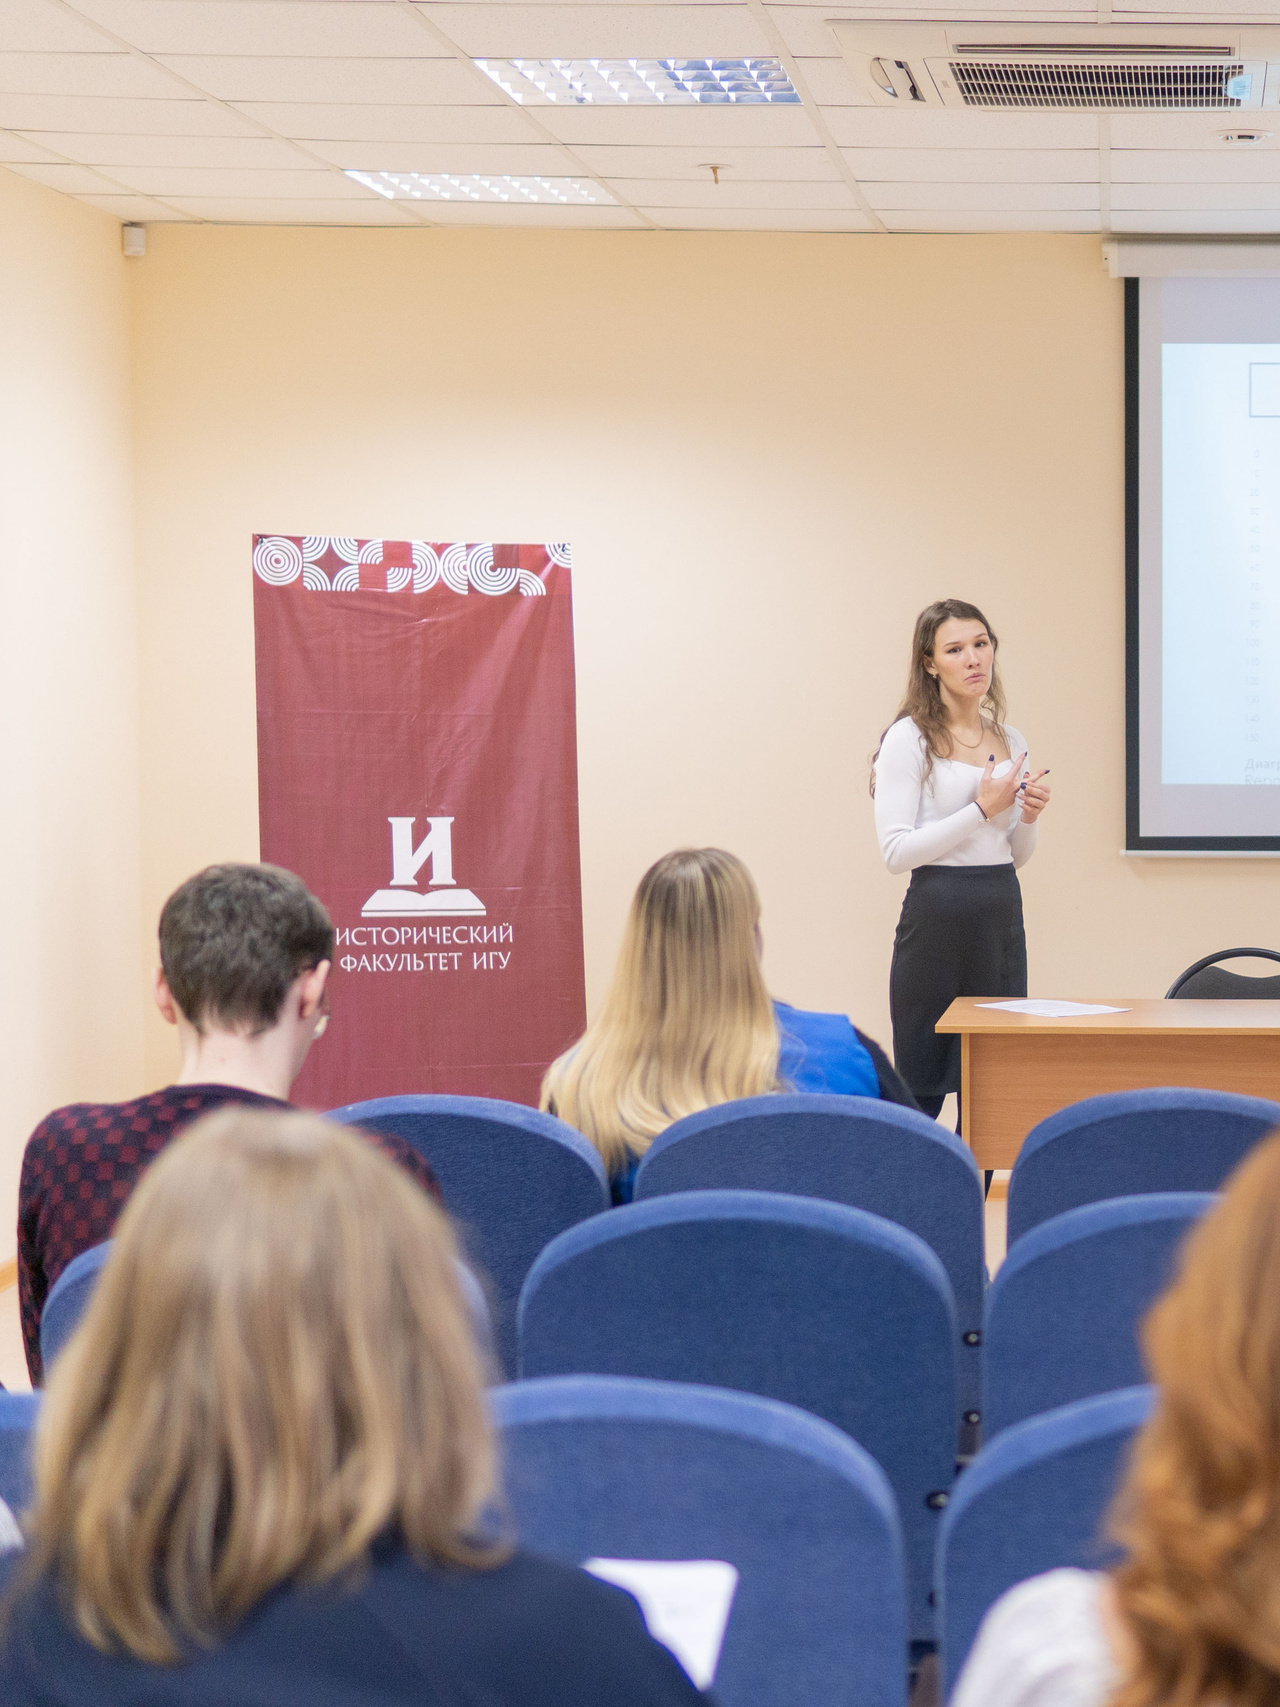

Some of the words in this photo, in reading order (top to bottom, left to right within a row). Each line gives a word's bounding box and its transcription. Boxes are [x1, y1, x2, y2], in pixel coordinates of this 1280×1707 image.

[336, 923, 514, 946] ИСТОРИЧЕСКИЙ
[340, 952, 463, 973] ФАКУЛЬТЕТ
[473, 951, 511, 970] ИГУ
